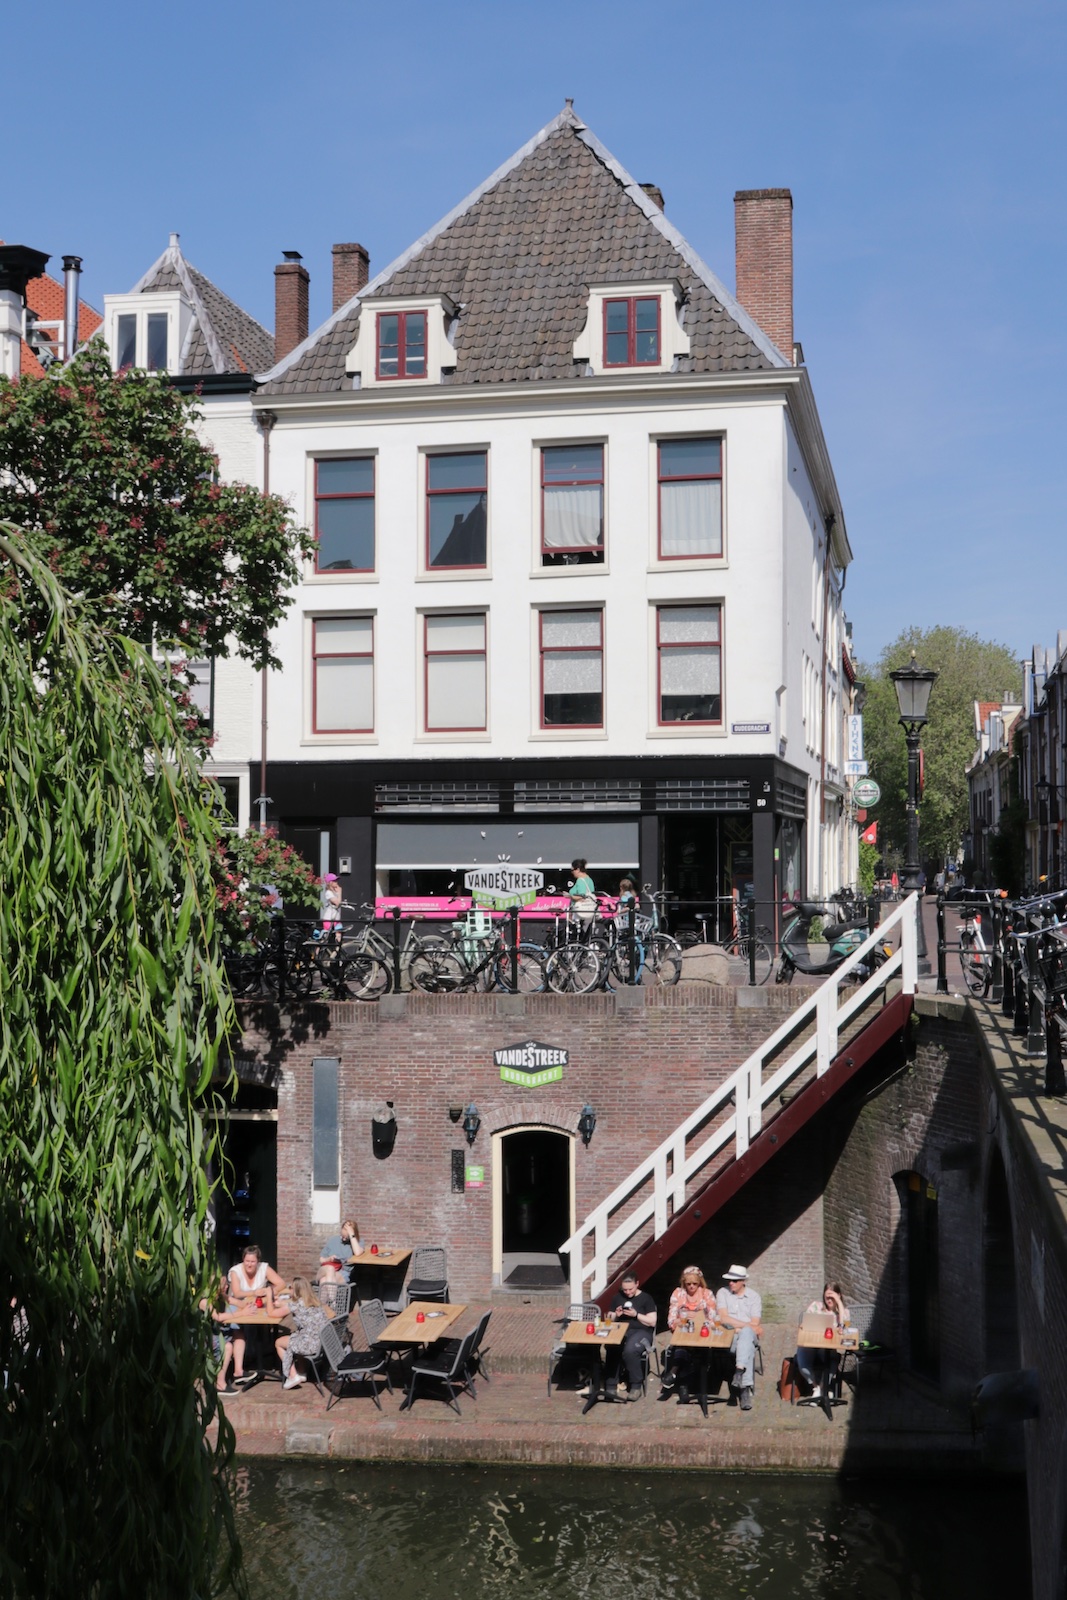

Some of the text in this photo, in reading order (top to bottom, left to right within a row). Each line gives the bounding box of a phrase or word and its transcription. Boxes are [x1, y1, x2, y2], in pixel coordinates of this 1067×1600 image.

[734, 724, 768, 732] OUDEGRACHT
[756, 798, 767, 807] 50
[467, 870, 541, 890] VANDESTREEK
[495, 1046, 568, 1069] VANDESTREEK
[504, 1069, 558, 1085] OUDEGRACHT
